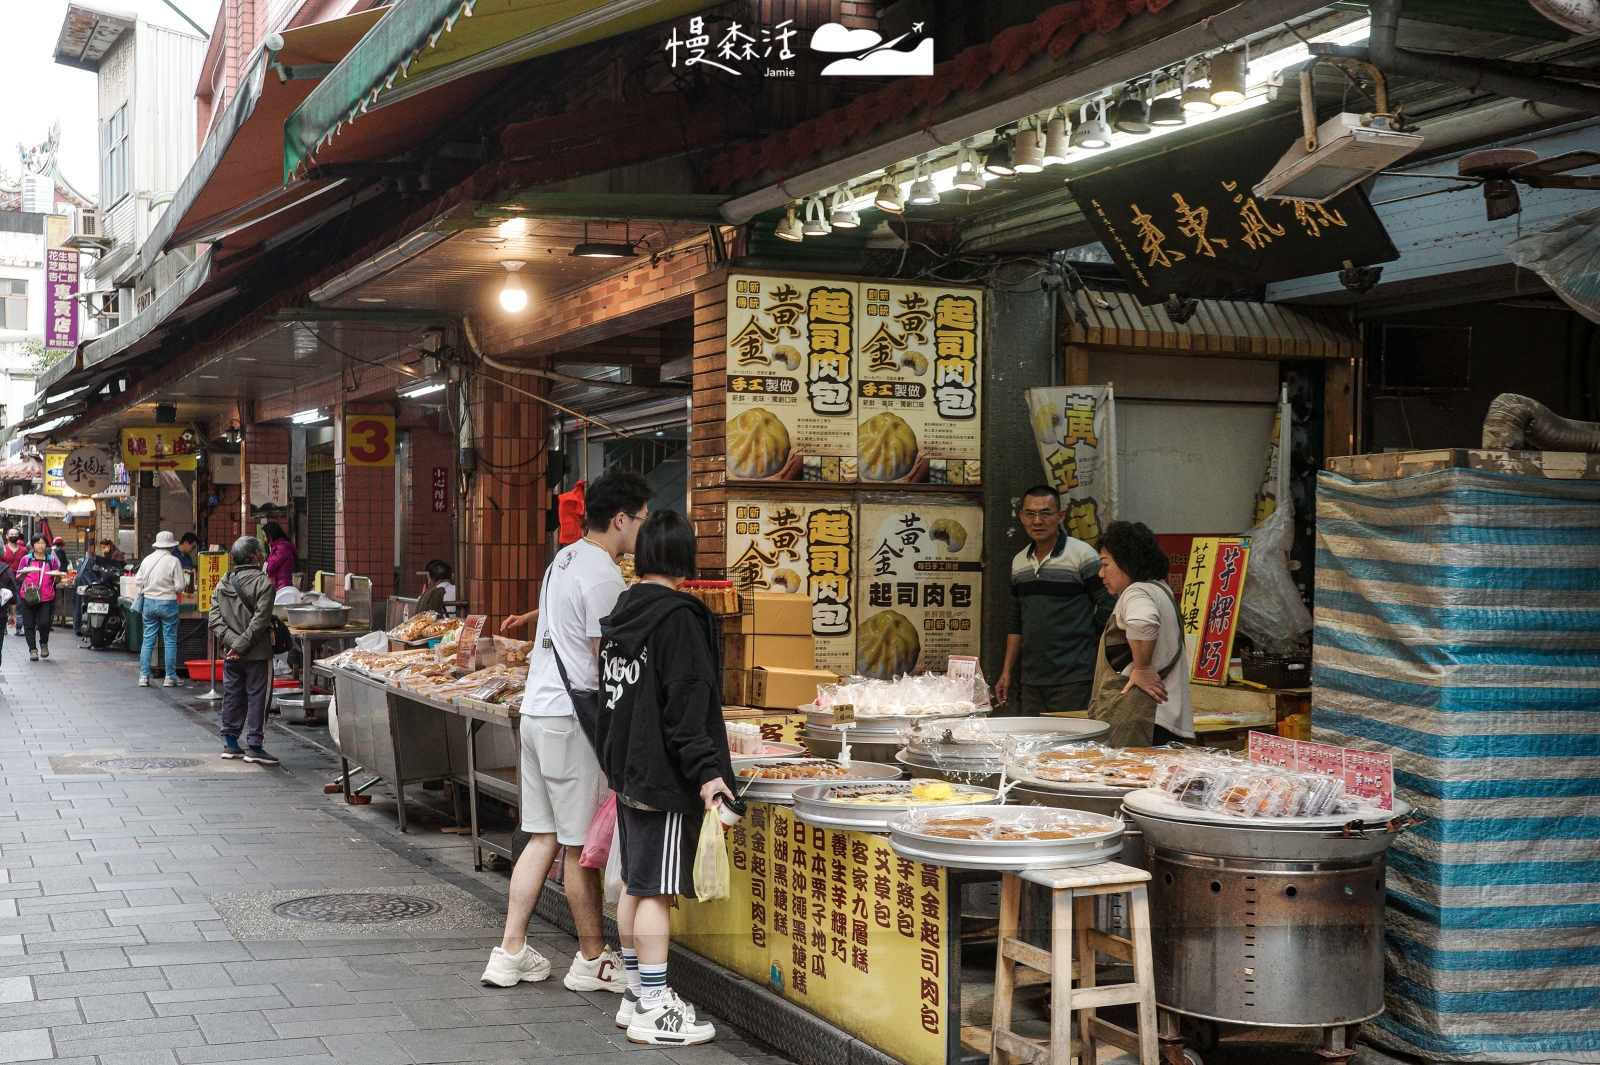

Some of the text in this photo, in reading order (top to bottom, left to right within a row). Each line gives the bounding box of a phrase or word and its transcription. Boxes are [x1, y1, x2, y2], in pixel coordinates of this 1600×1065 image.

[54, 284, 72, 333] 專賣店
[736, 280, 760, 294] 創新
[736, 296, 760, 309] 傳統
[867, 288, 890, 302] 創新
[867, 304, 890, 316] 傳統
[730, 283, 807, 367] 黃金
[807, 286, 852, 417] 起司肉包
[860, 291, 932, 372] 黃金
[934, 294, 979, 420] 起司肉包
[732, 377, 793, 393] 手工製做
[862, 382, 920, 397] 手工製做
[350, 420, 390, 462] 3
[434, 468, 444, 512] 小心階梯
[736, 506, 760, 519] 創新
[736, 522, 760, 534] 傳統
[868, 512, 926, 576] 黃金
[208, 556, 220, 604] 清潔
[807, 508, 852, 637] 起司肉包
[869, 582, 972, 608] 起司肉包
[1182, 542, 1209, 634] 草阿粿
[1200, 546, 1240, 678] 芋粿巧
[732, 814, 746, 871] 簽包
[751, 807, 766, 948] 黃金起司肉包
[774, 814, 788, 938] 澎湖黑糖糕
[792, 820, 808, 996] 日本沖繩黑糖糕
[812, 827, 827, 980] 日本栗子地瓜
[831, 832, 848, 964] 養生芋粿巧
[852, 840, 868, 974] 客家九層糕
[874, 847, 891, 928] 艾草包
[597, 960, 614, 982] C
[920, 862, 940, 1034] 黃金起司肉包
